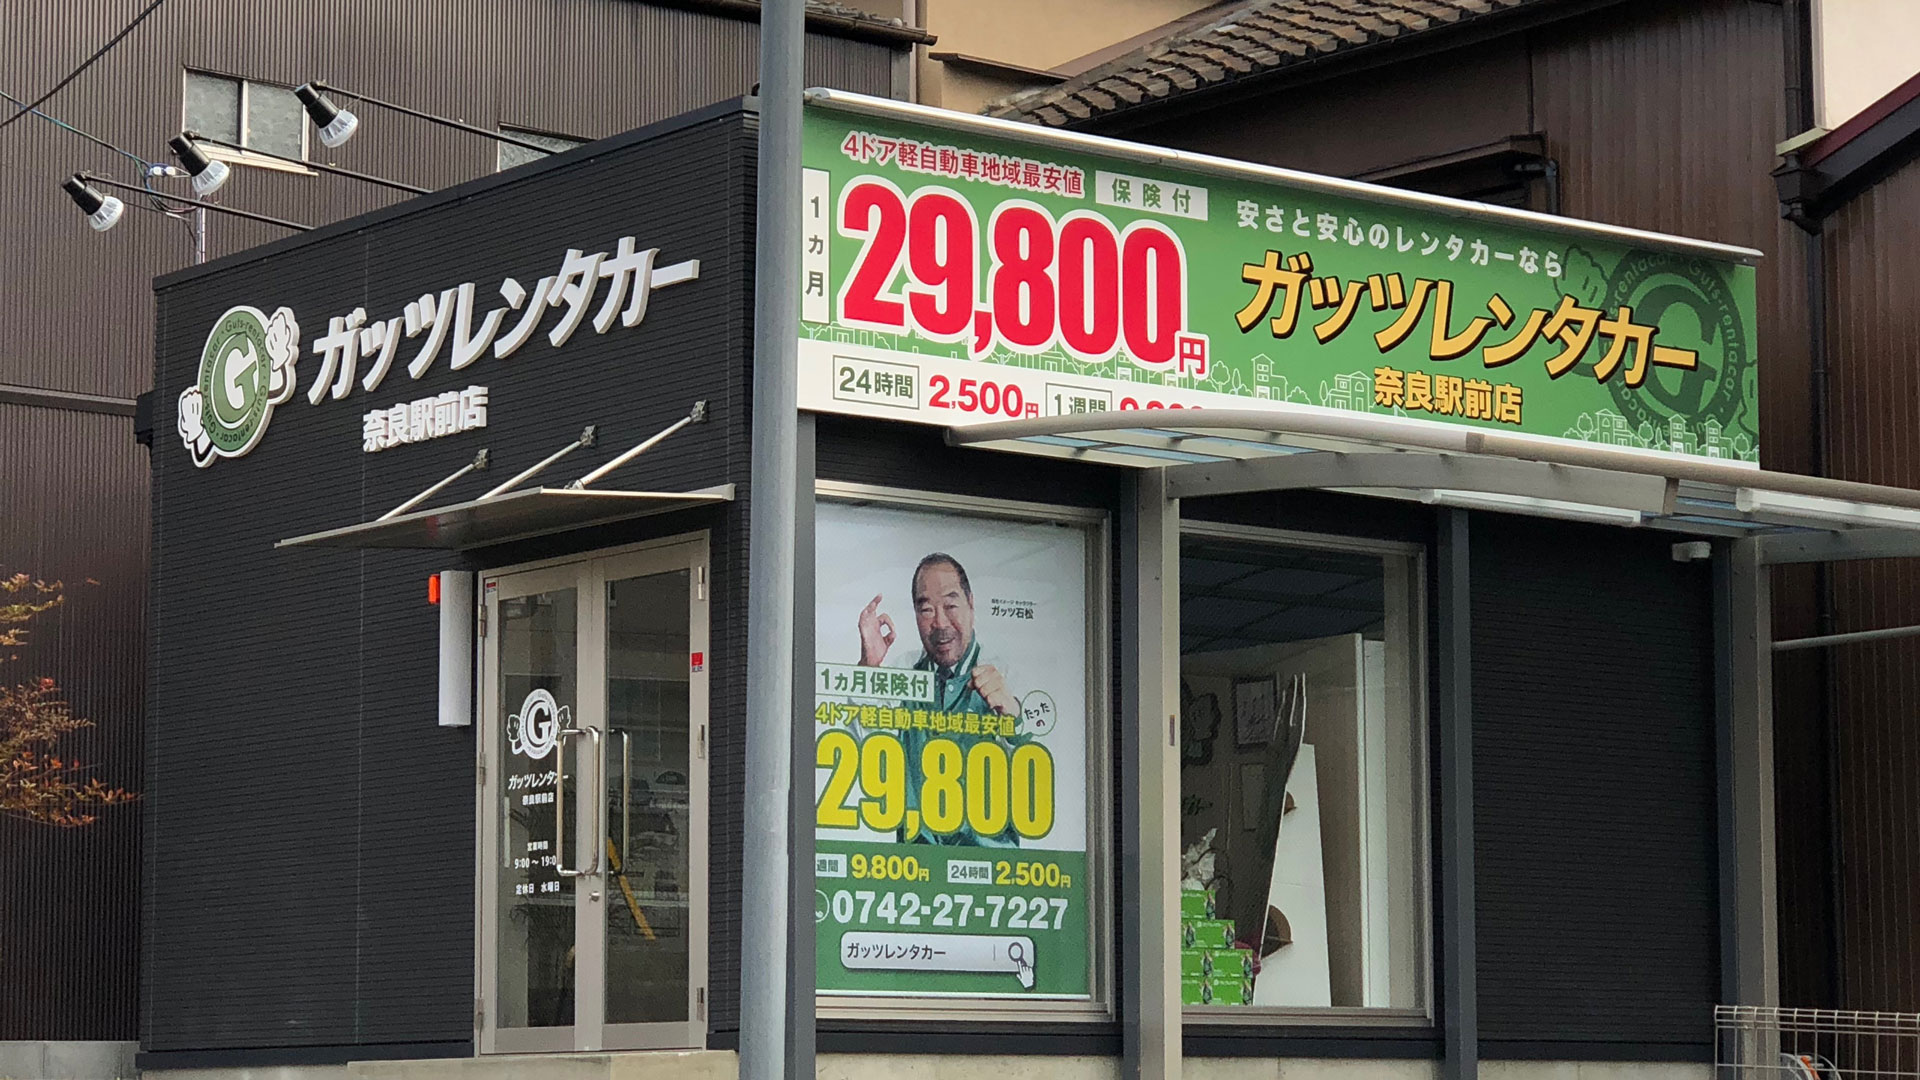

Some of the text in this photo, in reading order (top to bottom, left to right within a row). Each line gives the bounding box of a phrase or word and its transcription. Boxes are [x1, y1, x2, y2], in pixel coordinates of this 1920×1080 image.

[842, 133, 1084, 196] 4ドア軽自動車地域最安値
[1111, 177, 1192, 214] 保険付
[1236, 200, 1563, 278] 安さと安心のレンタカーなら
[308, 236, 700, 405] ガッツレンタカー
[1235, 249, 1698, 389] ガッツレンタカー
[213, 331, 258, 424] G
[838, 366, 914, 399] 24時間
[1373, 366, 1523, 425] 奈良駅前店
[363, 384, 489, 452] 奈良駅前店
[991, 605, 1034, 620] ガッツ石松
[527, 702, 552, 746] G
[815, 702, 1016, 737] 4ドア軽自動車地域最安値
[1024, 702, 1051, 720] たった
[1035, 719, 1046, 727] の
[816, 730, 1055, 841] 29,800
[514, 857, 530, 869] 9:00
[951, 864, 989, 880] 24時間
[832, 889, 1069, 930] 0742-27-7227
[847, 943, 946, 960] ガッツレンタカー
